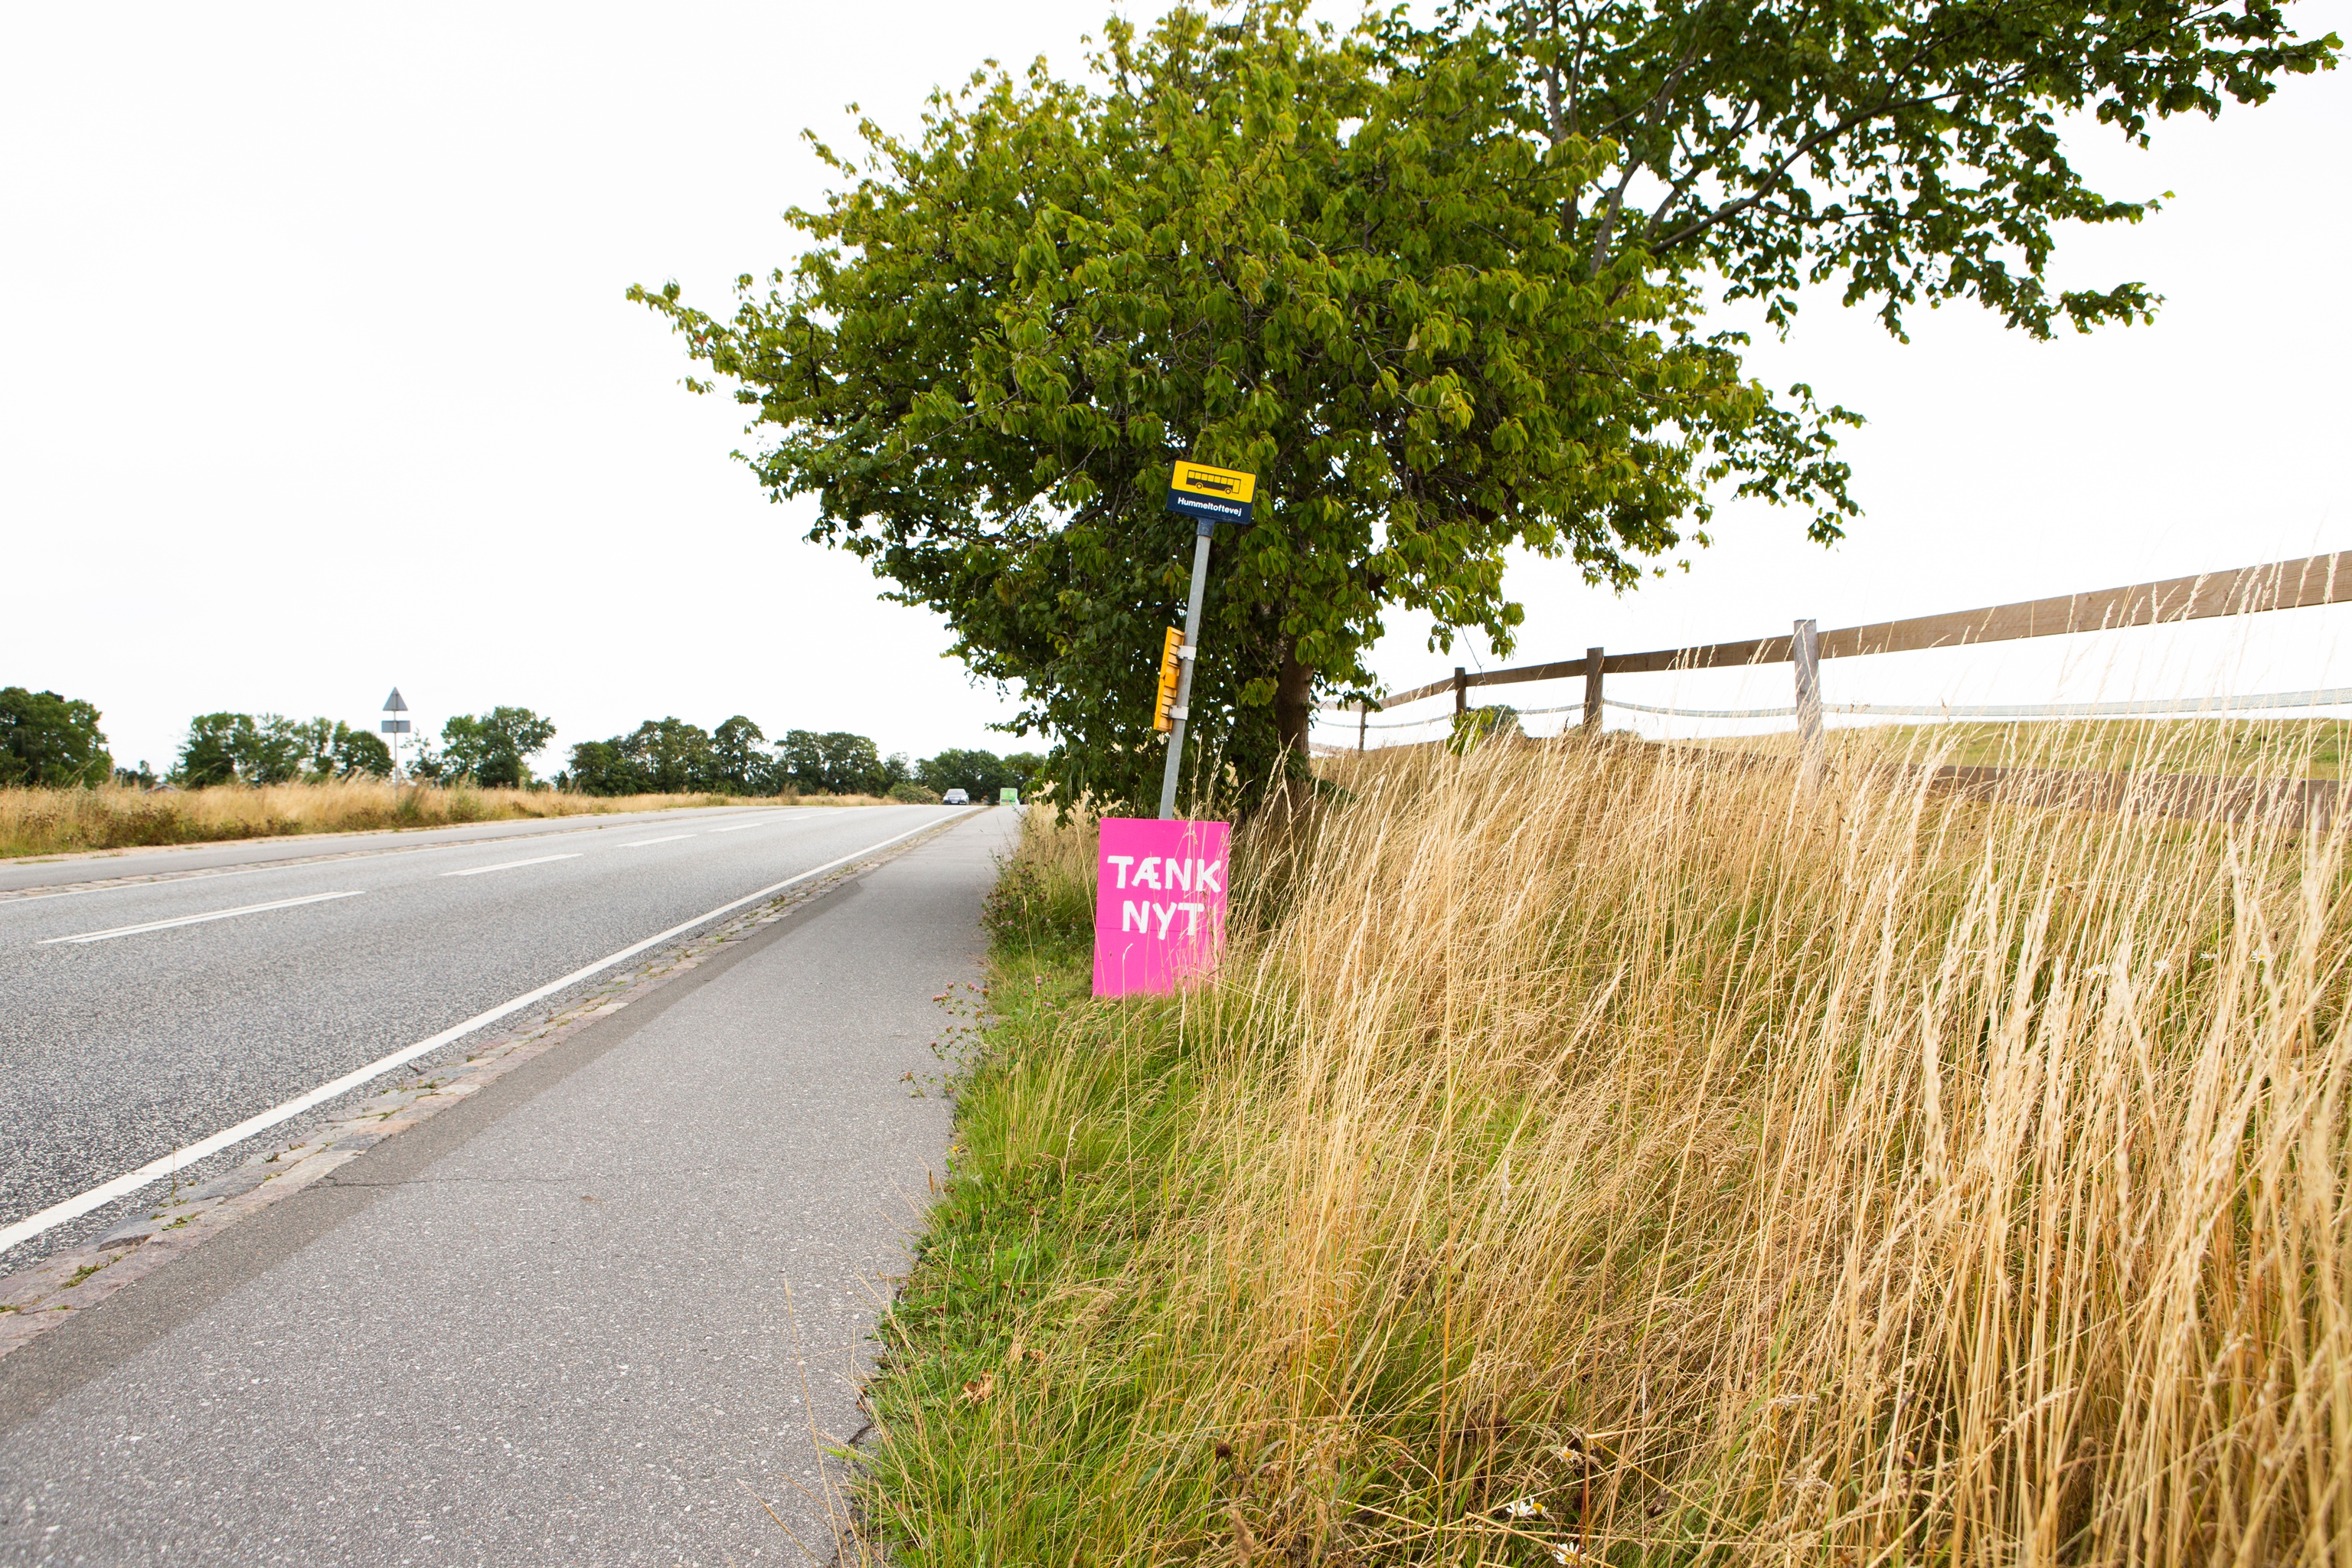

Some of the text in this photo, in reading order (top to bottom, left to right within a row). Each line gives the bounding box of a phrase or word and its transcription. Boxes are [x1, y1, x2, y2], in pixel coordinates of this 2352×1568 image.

[1178, 497, 1242, 517] Hummeltoftevej
[1107, 855, 1222, 893] TÆNK
[1122, 900, 1205, 940] NYT
